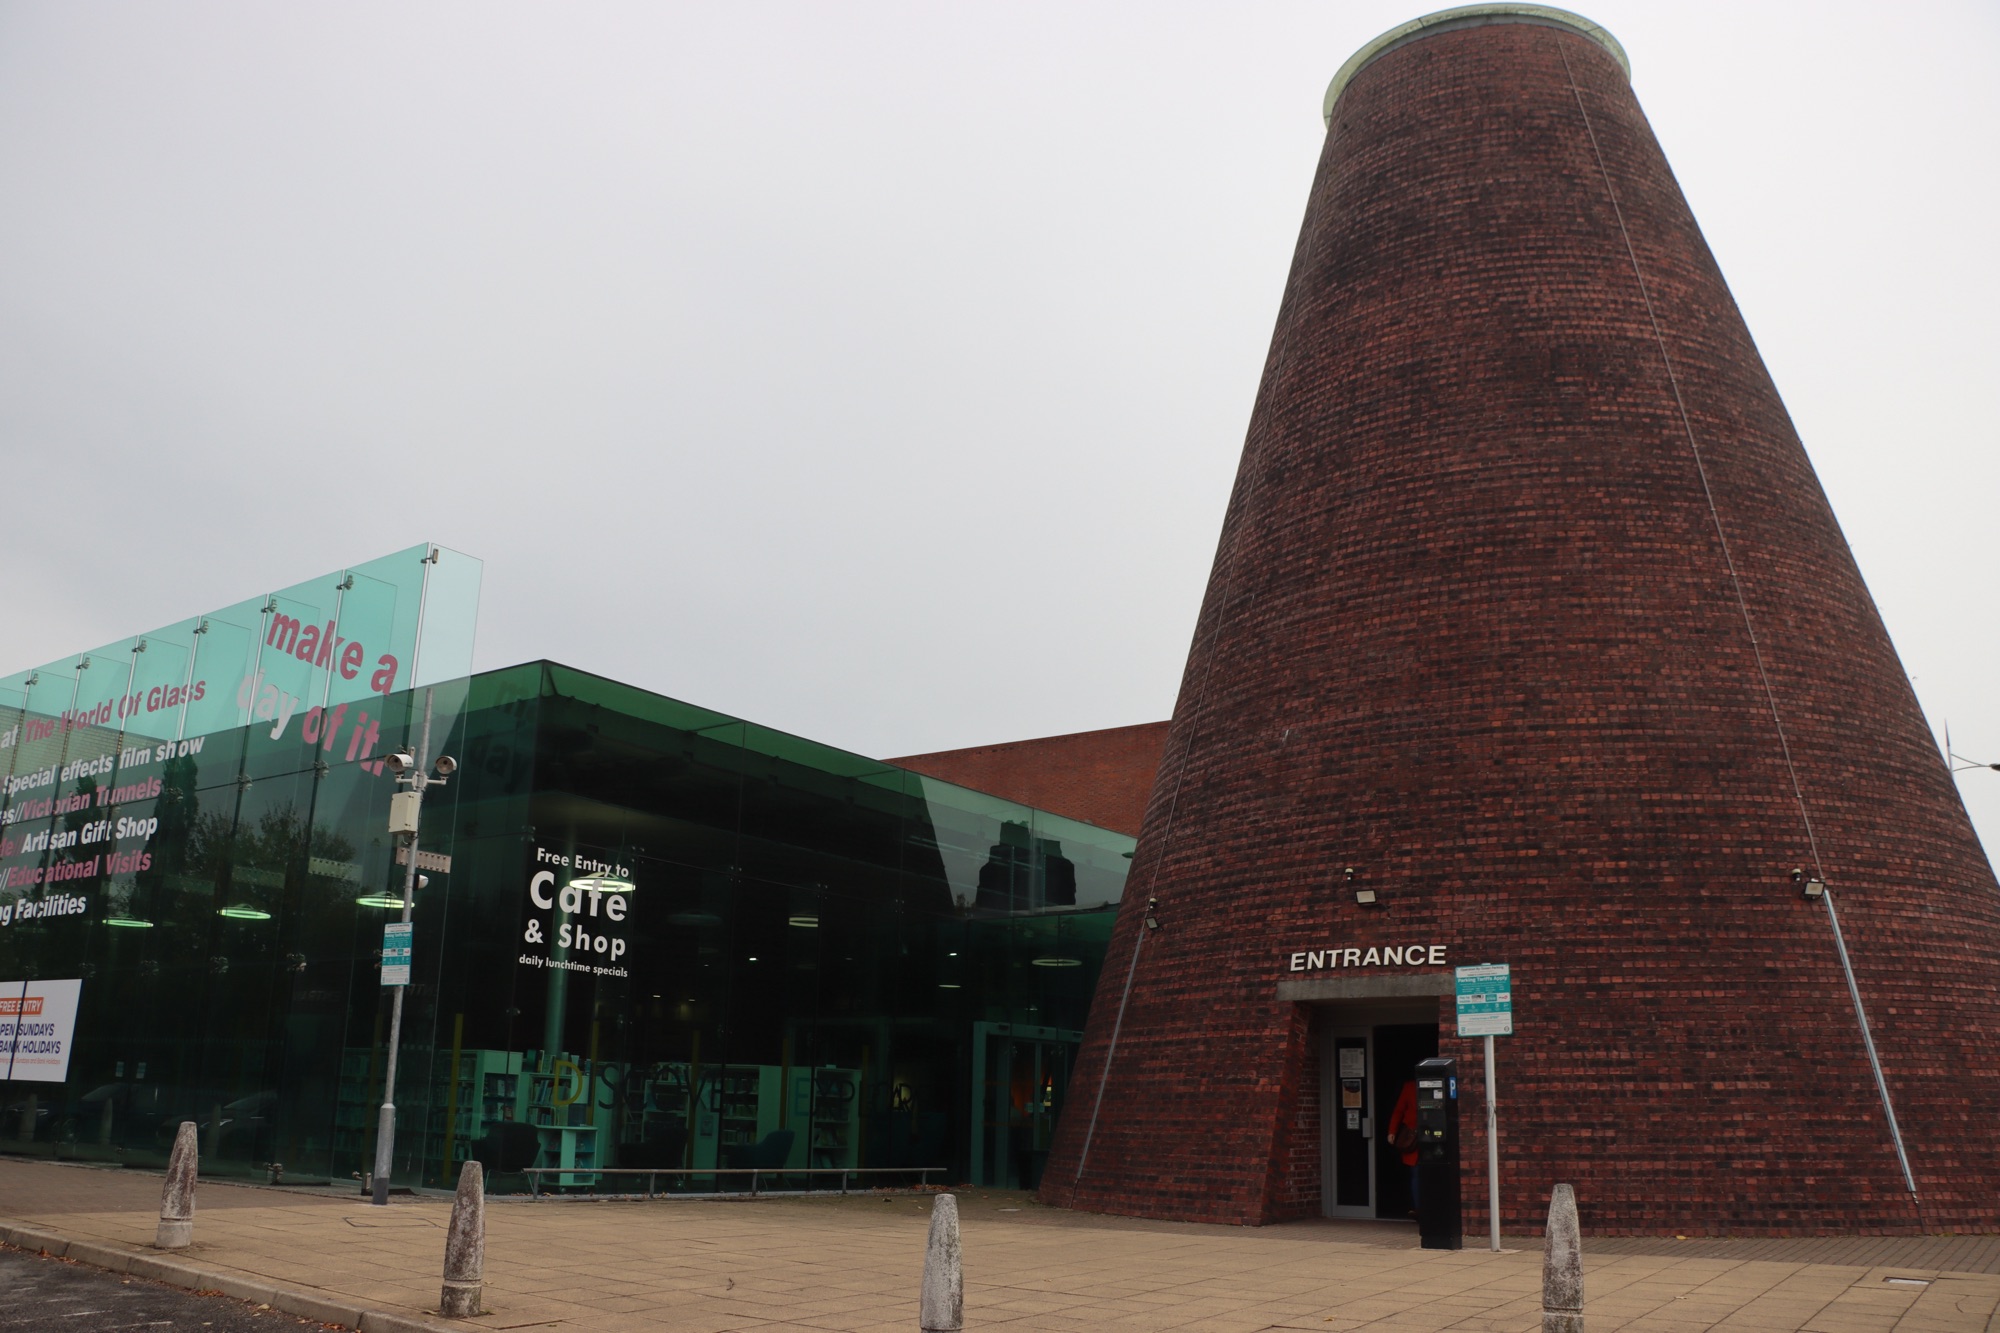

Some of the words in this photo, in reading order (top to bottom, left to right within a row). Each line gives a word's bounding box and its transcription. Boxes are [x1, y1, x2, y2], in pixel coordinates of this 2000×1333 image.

[266, 612, 364, 680] make
[371, 653, 398, 696] a
[25, 718, 54, 743] The
[59, 698, 114, 734] World
[118, 690, 143, 719] Of
[146, 680, 207, 712] Glass
[237, 668, 300, 741] day
[302, 703, 348, 753] of
[2, 765, 56, 798] Special
[60, 753, 114, 783] effects
[119, 747, 151, 770] film
[156, 736, 205, 762] show
[95, 776, 162, 806] Tunnels
[81, 820, 111, 846] Gift
[115, 815, 158, 841] Shop
[106, 849, 152, 874] Visits
[536, 847, 570, 867] Free
[574, 854, 612, 878] Entry
[615, 864, 629, 878] to
[14, 893, 87, 920] Facilities
[530, 870, 628, 922] Café
[524, 918, 544, 944] &
[557, 923, 626, 961] Shop
[519, 954, 543, 969] daily
[545, 957, 591, 973] lunchtime
[592, 965, 628, 978] specials
[1290, 945, 1447, 972] ENTRANCE
[17, 1000, 42, 1012] ENTRY
[0, 1023, 15, 1036] PEN
[17, 1023, 55, 1037] SUNDAYS
[22, 1040, 61, 1055] HOLIDAYS
